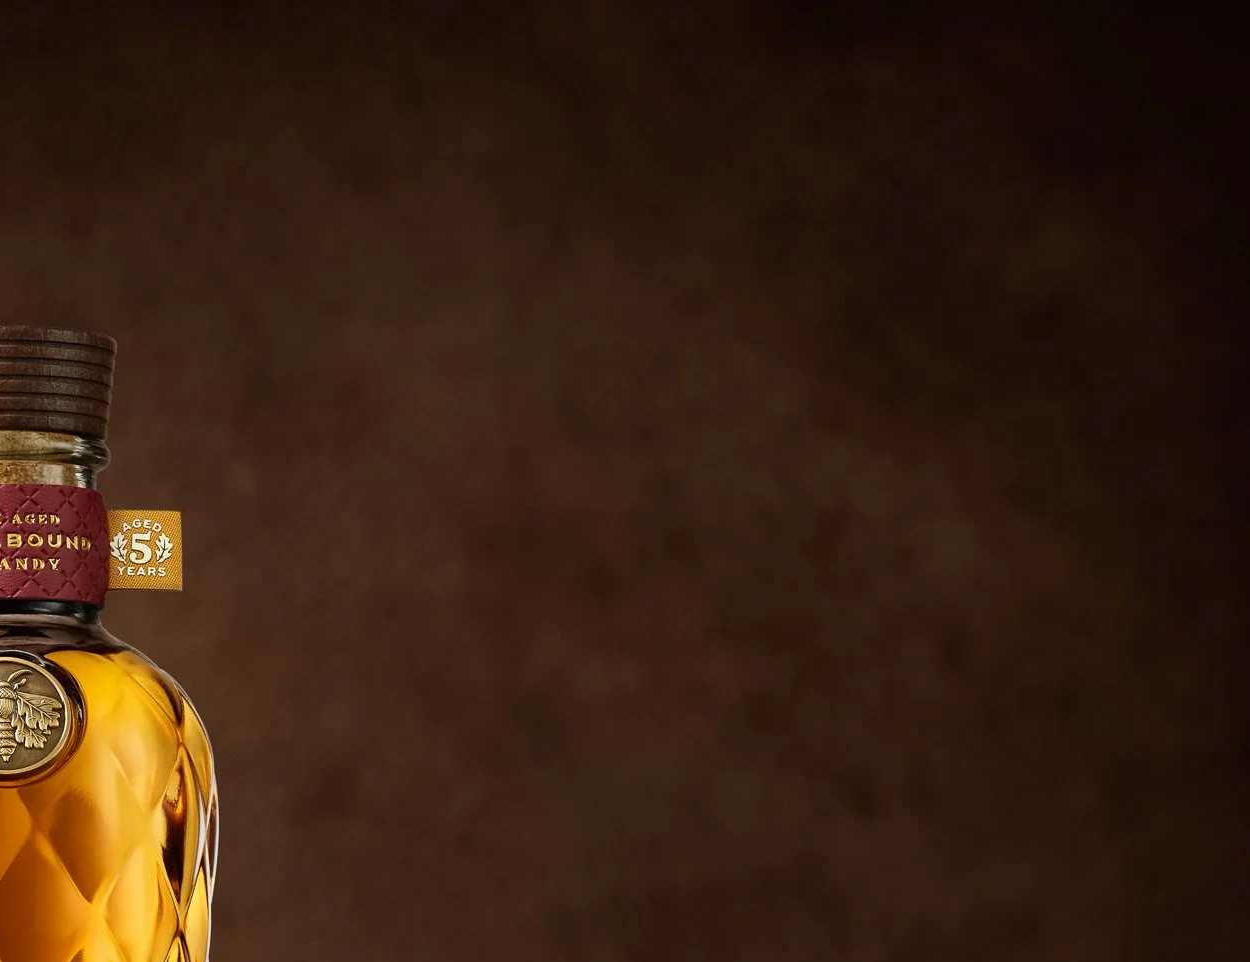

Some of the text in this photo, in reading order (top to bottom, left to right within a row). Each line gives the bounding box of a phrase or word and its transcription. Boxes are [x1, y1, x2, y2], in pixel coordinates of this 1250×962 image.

[12, 513, 60, 525] AGED
[122, 519, 162, 532] AGED
[130, 532, 152, 564] 5
[118, 566, 166, 576] YEARS
